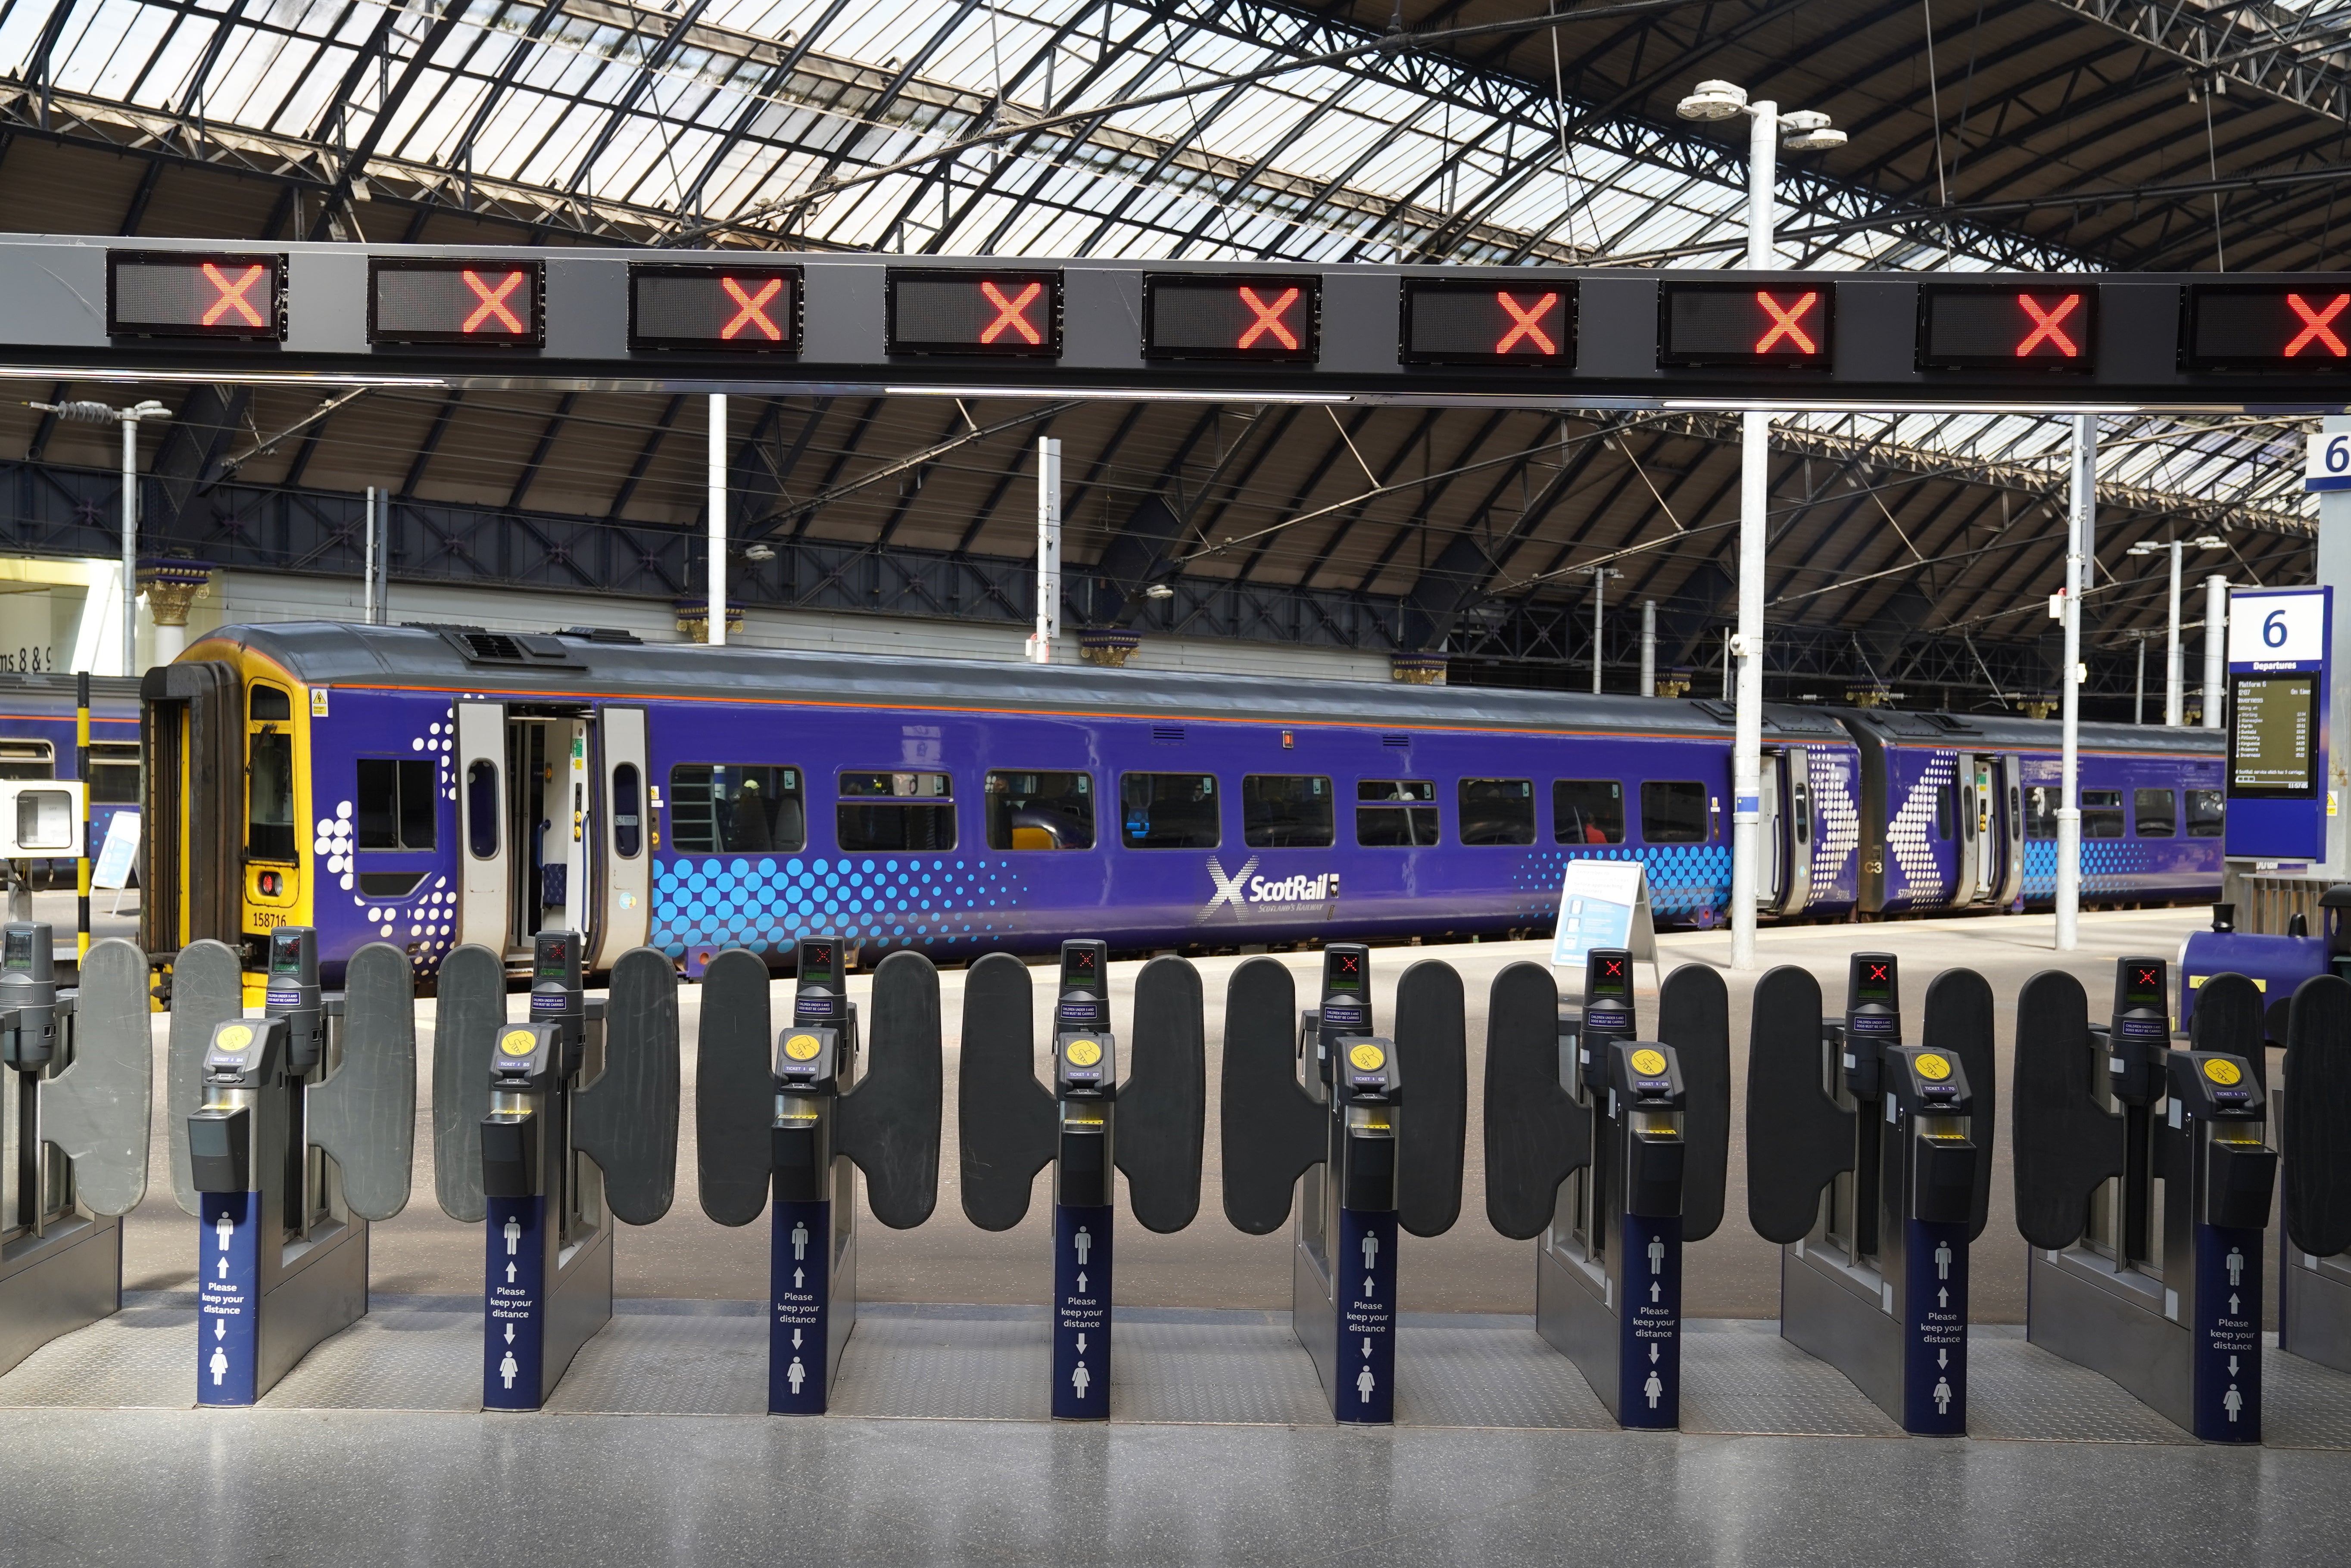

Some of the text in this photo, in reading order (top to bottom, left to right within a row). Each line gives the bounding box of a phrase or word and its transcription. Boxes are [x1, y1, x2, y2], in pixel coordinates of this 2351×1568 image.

[2326, 436, 2349, 472] 6
[2263, 610, 2287, 648] 6
[20, 647, 41, 672] 8 &
[2253, 661, 2297, 671] Departures
[1865, 862, 1882, 874] C3
[1250, 873, 1328, 902] ScotRail
[1898, 889, 1912, 898] 57716
[253, 912, 286, 927] 158716
[209, 1282, 237, 1291] Please
[202, 1293, 221, 1304] keep
[491, 1297, 510, 1308] keep
[204, 1305, 240, 1314] distance
[778, 1303, 797, 1313] keep
[1062, 1308, 1081, 1318] keep
[493, 1310, 528, 1318] distance
[780, 1315, 816, 1323] distance
[1347, 1312, 1367, 1322] keep
[1634, 1318, 1654, 1327] keep
[1921, 1323, 1942, 1333] keep
[2211, 1329, 2233, 1340] keep
[2214, 1341, 2251, 1350] distance
